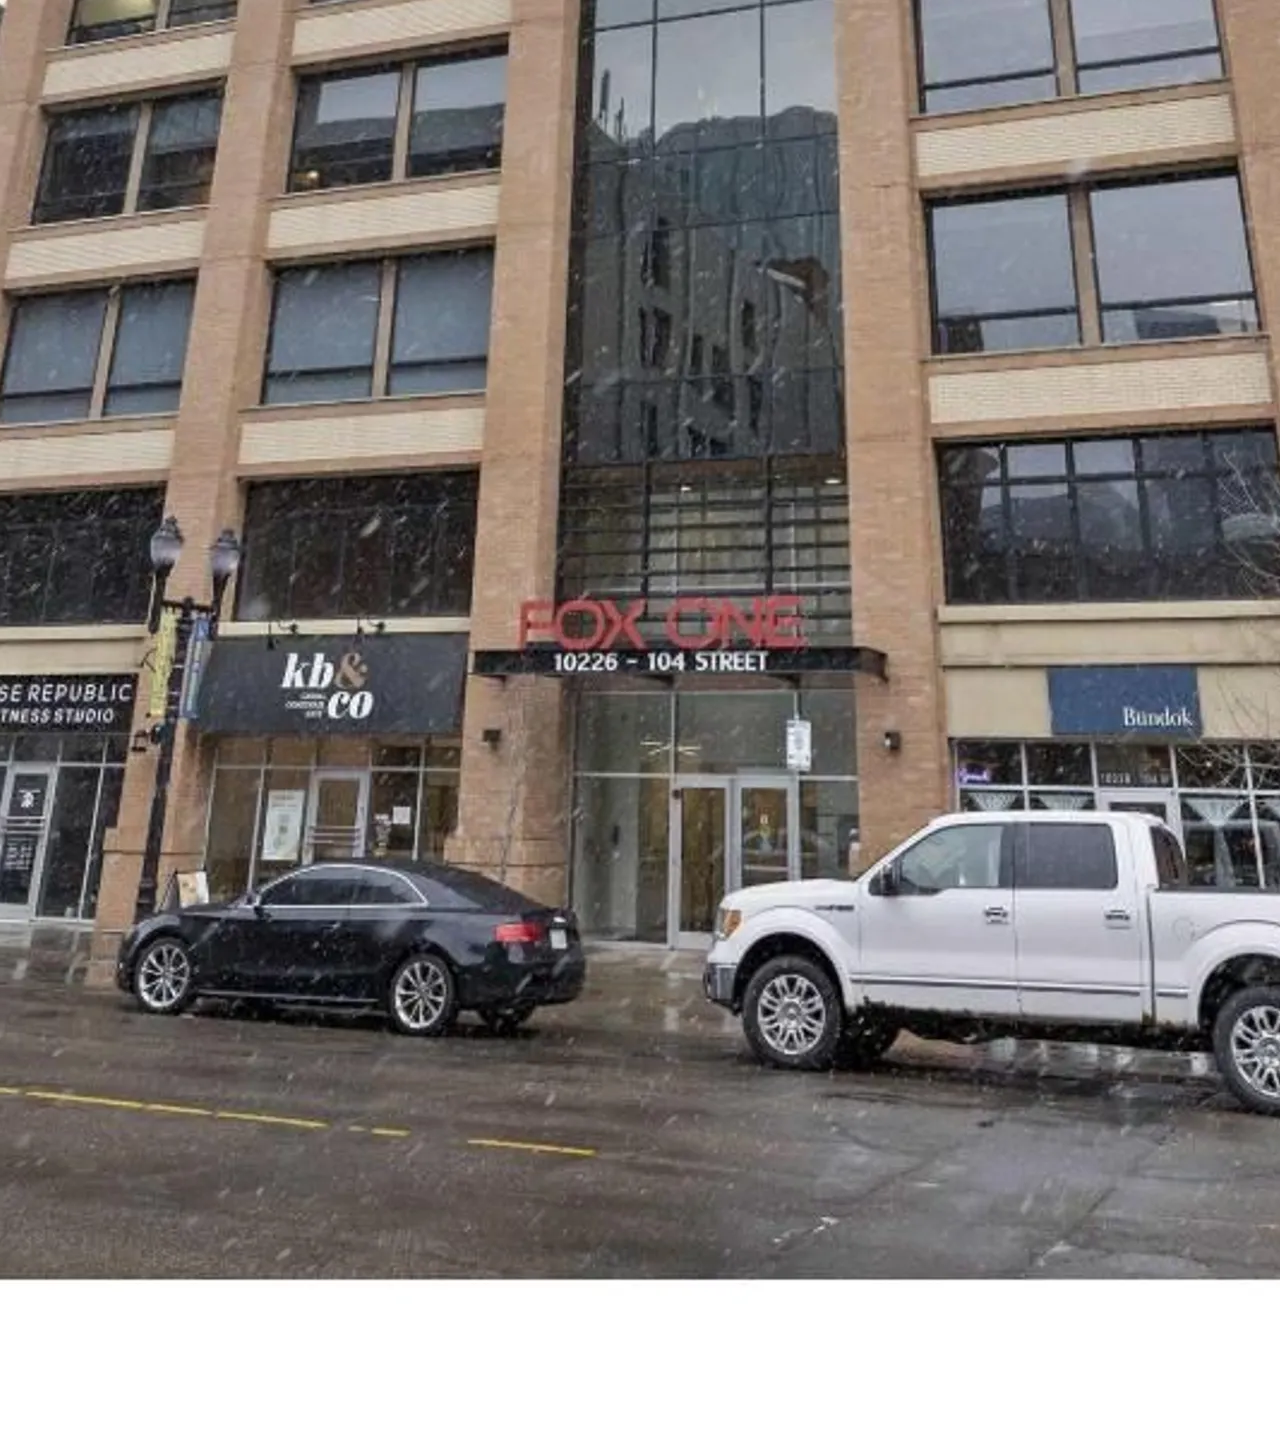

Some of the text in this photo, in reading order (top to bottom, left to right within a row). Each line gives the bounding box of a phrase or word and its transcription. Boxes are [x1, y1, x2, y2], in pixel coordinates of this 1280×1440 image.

[517, 595, 809, 651] FOX ONE
[553, 652, 618, 672] 10226
[647, 652, 685, 672] 104
[695, 651, 769, 672] STREET
[27, 683, 133, 703] REPUBLIC
[53, 708, 115, 723] STUDIO
[327, 691, 374, 719] co
[1122, 706, 1194, 727] Bundok
